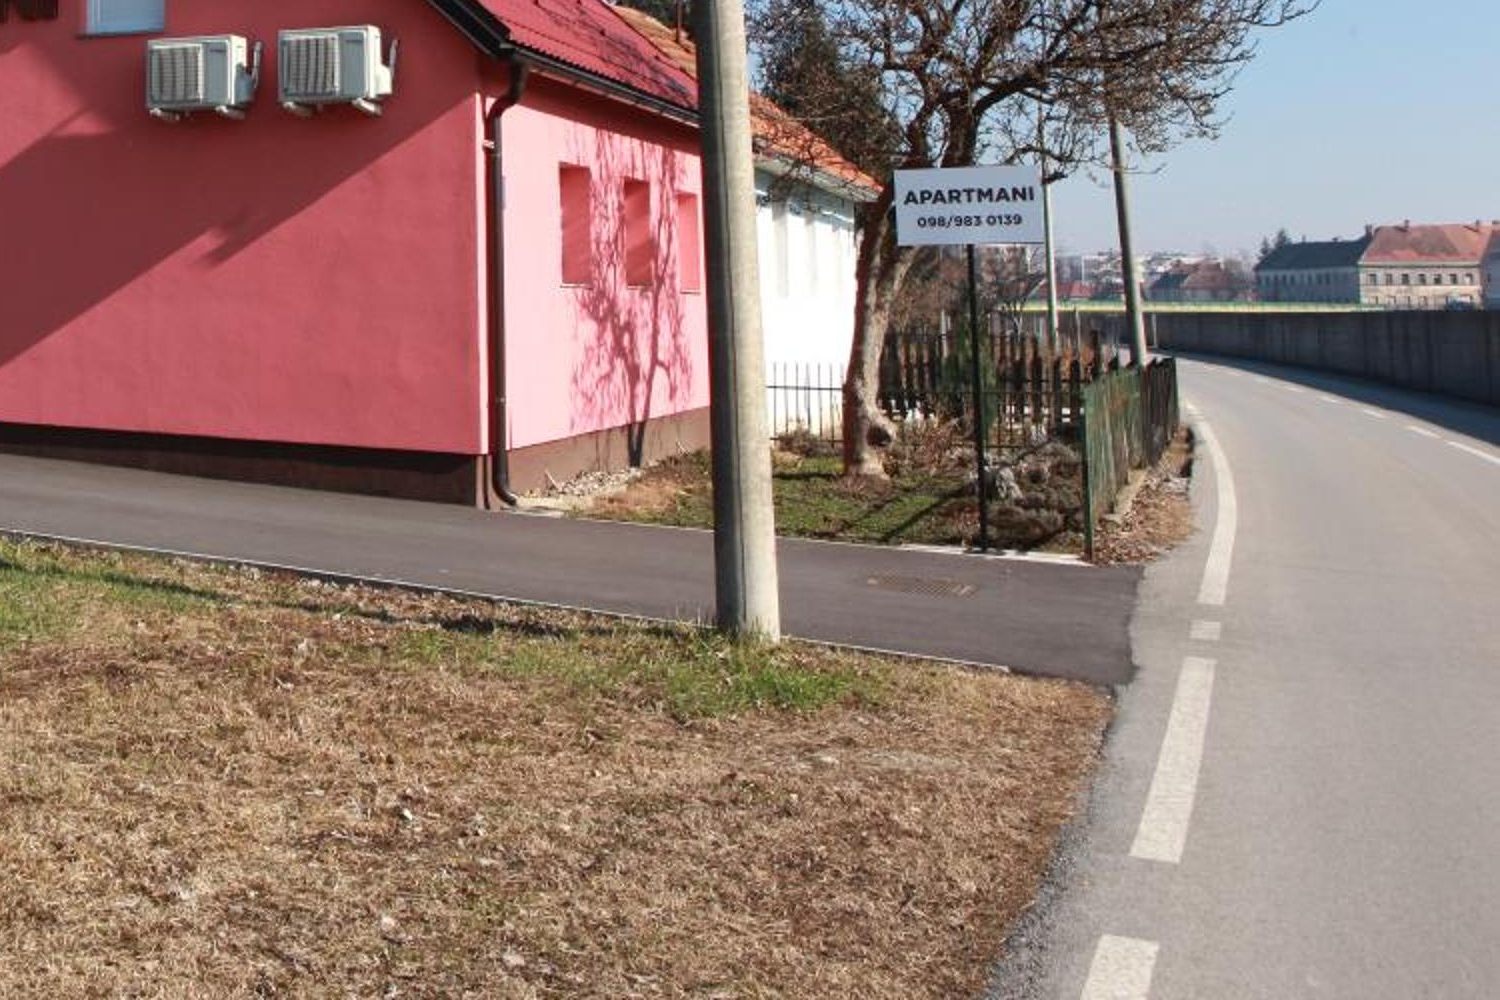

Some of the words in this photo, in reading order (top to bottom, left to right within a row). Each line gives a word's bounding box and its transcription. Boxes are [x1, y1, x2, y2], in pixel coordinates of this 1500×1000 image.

[903, 186, 1035, 205] APARTMANI
[917, 215, 982, 228] 098/983
[986, 213, 1022, 226] 0139
